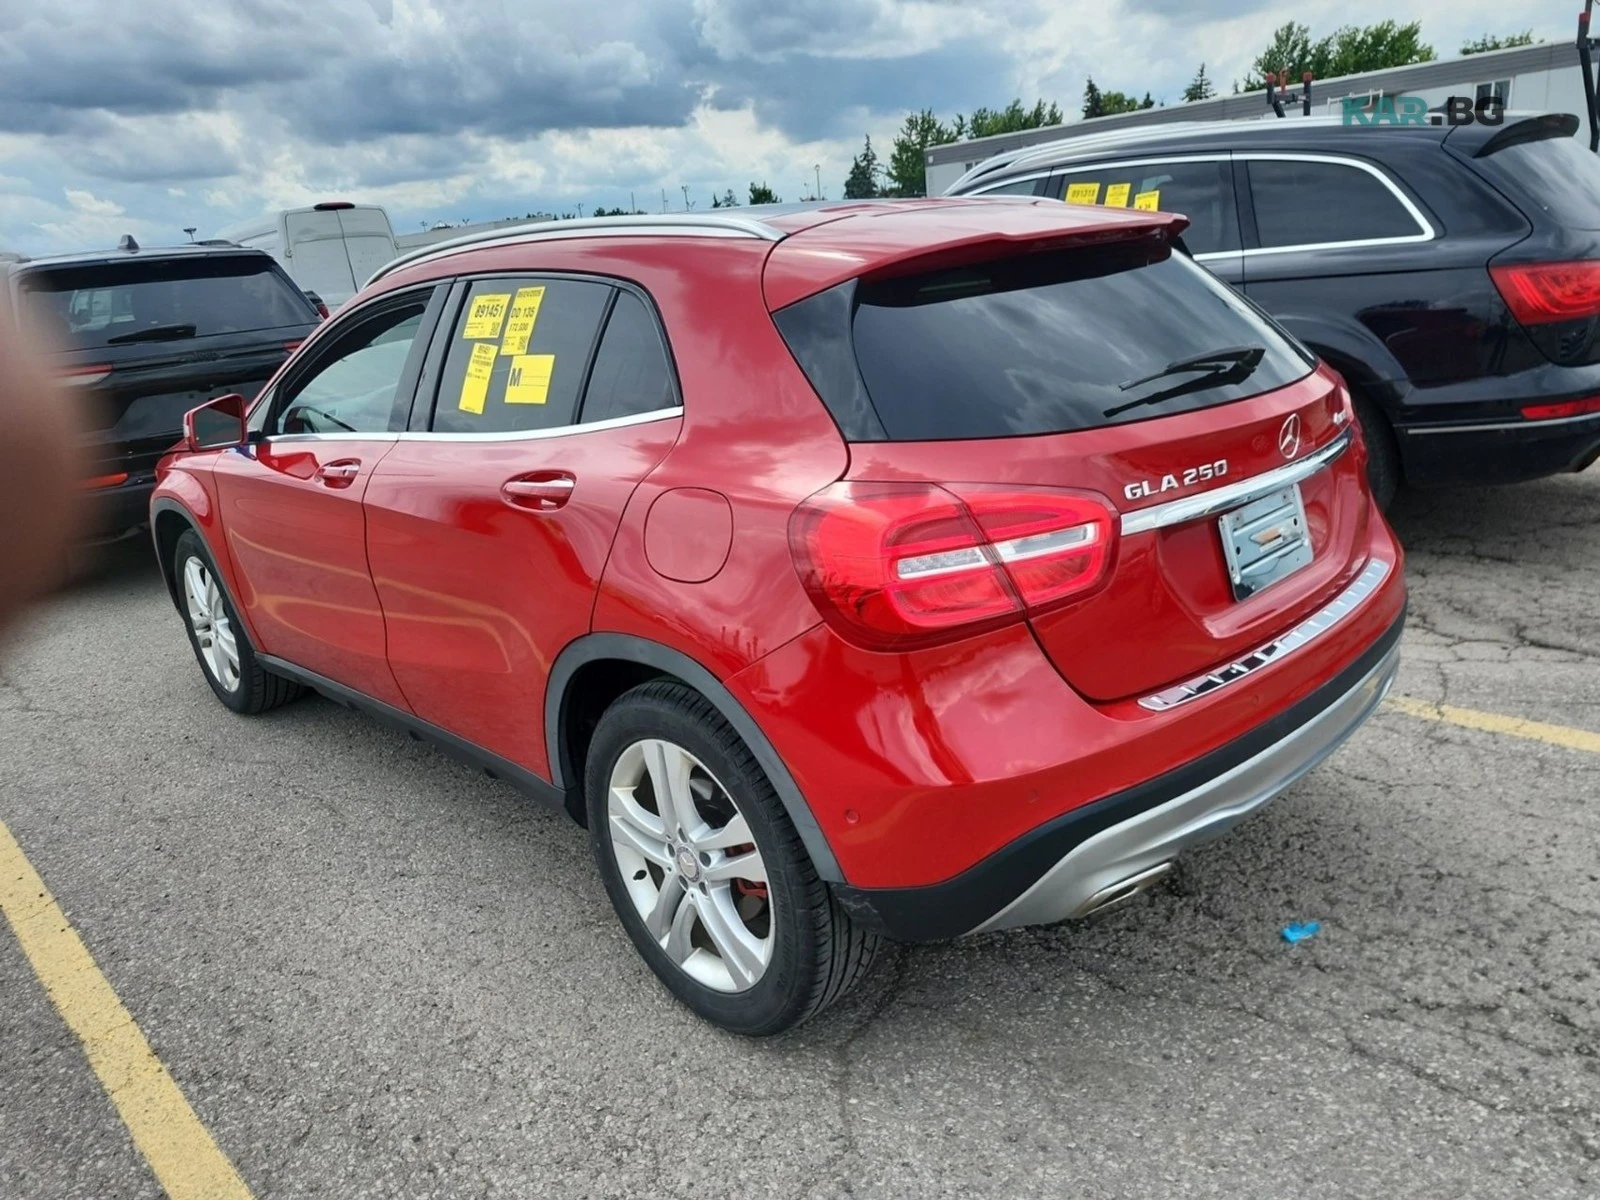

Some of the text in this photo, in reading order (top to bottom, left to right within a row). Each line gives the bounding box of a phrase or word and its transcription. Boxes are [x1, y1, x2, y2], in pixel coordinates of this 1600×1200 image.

[474, 304, 506, 318] 891451
[509, 367, 523, 387] M
[1124, 459, 1228, 500] GLA 250
